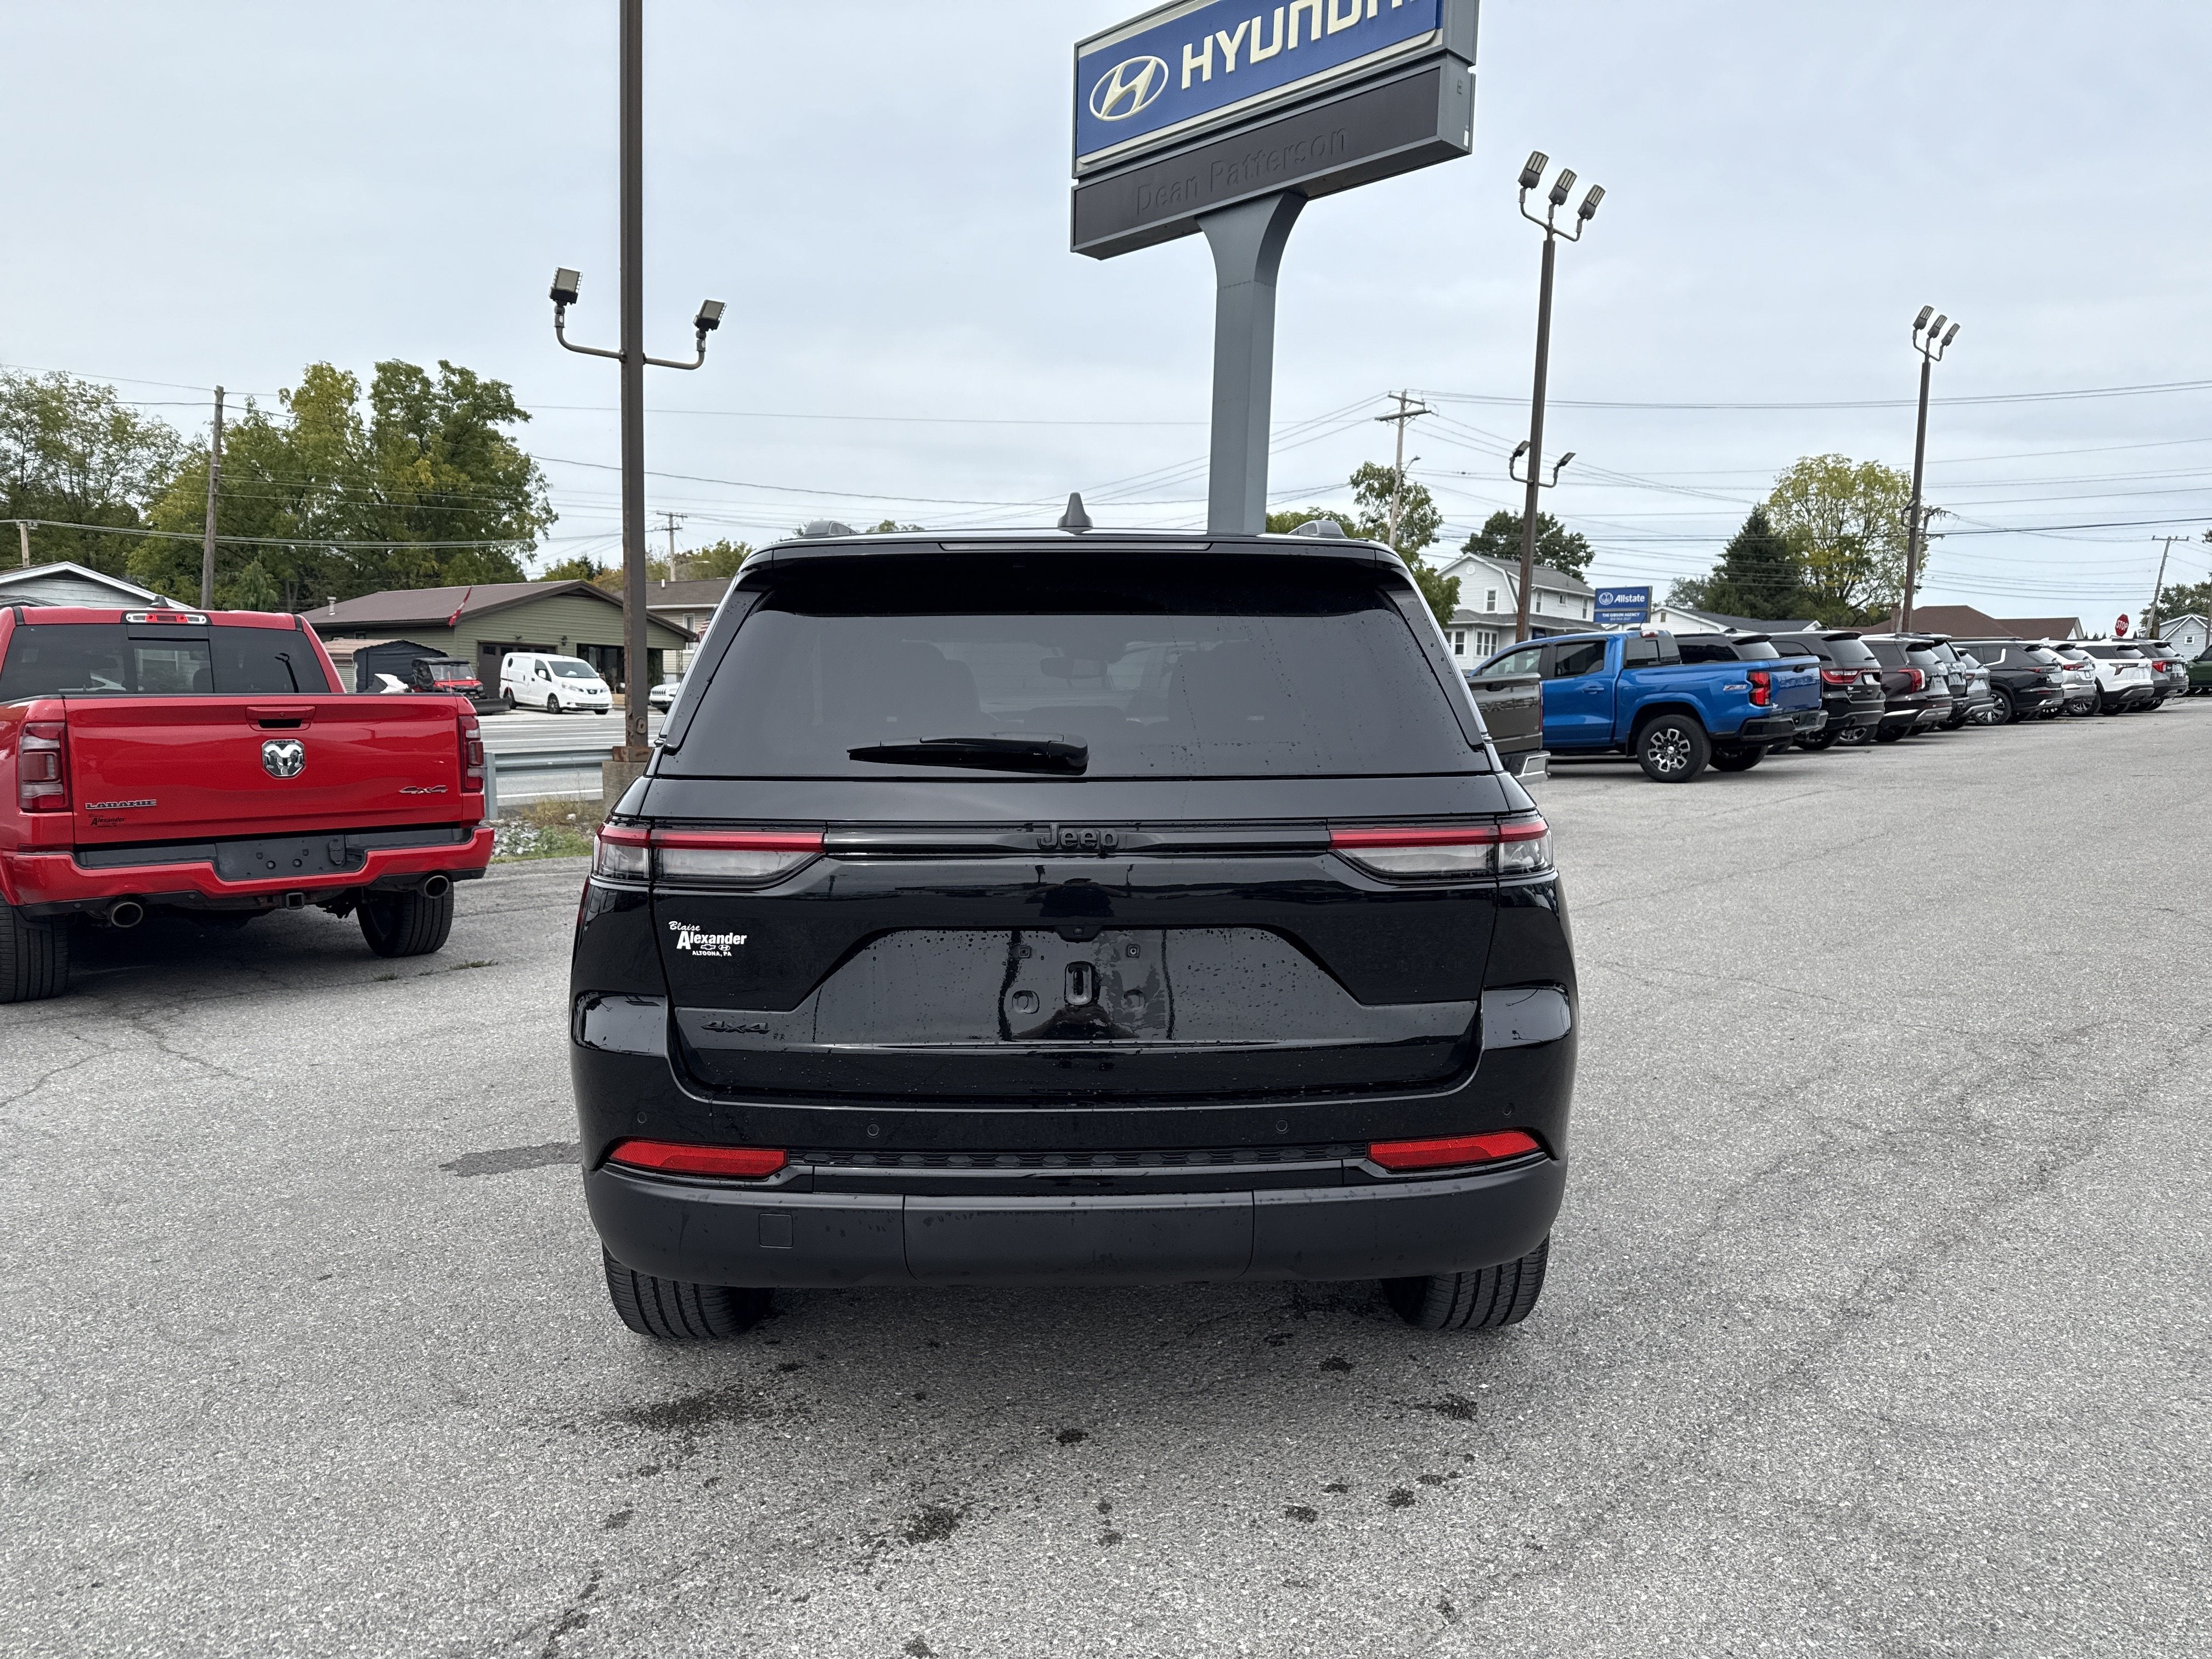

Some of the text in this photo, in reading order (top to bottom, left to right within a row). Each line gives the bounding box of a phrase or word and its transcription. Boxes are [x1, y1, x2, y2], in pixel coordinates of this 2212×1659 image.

[1181, 0, 1418, 89] HYUND
[1137, 127, 1348, 216] Dean Patterson
[1614, 594, 1645, 603] Allstate
[2116, 619, 2129, 631] STOP
[85, 799, 157, 810] LARAMIE
[90, 817, 126, 826] Alexander
[1037, 822, 1119, 851] Jeep
[668, 921, 701, 931] Blaise
[676, 930, 747, 950] Alexander
